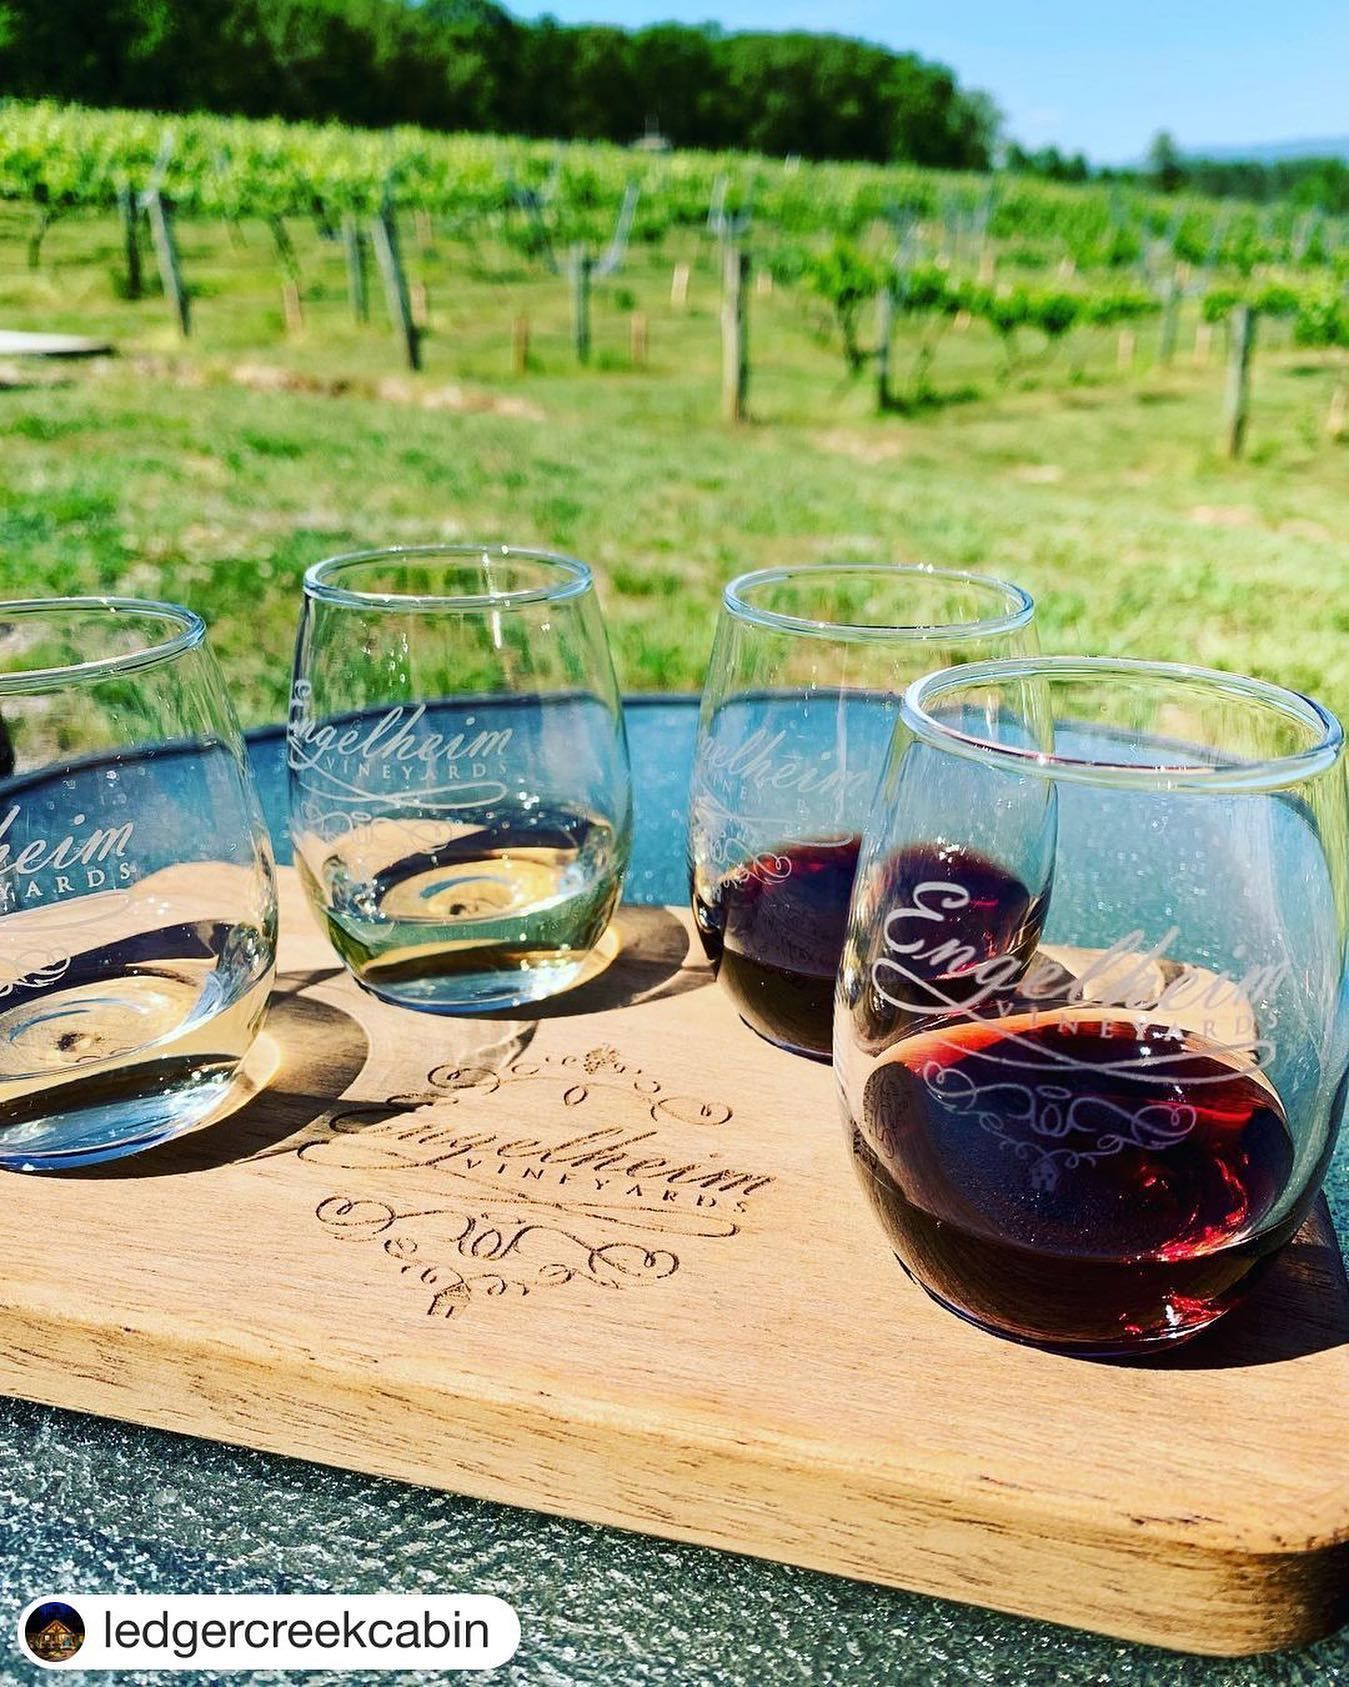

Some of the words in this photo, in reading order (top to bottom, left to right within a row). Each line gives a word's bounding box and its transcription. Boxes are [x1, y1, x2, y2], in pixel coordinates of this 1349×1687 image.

[324, 755, 507, 781] VINEYARDS
[872, 880, 1292, 1015] Engelheim
[997, 999, 1279, 1042] VINEYARDS
[297, 1092, 777, 1197] Engelheim
[466, 1157, 748, 1213] VINEYARDS
